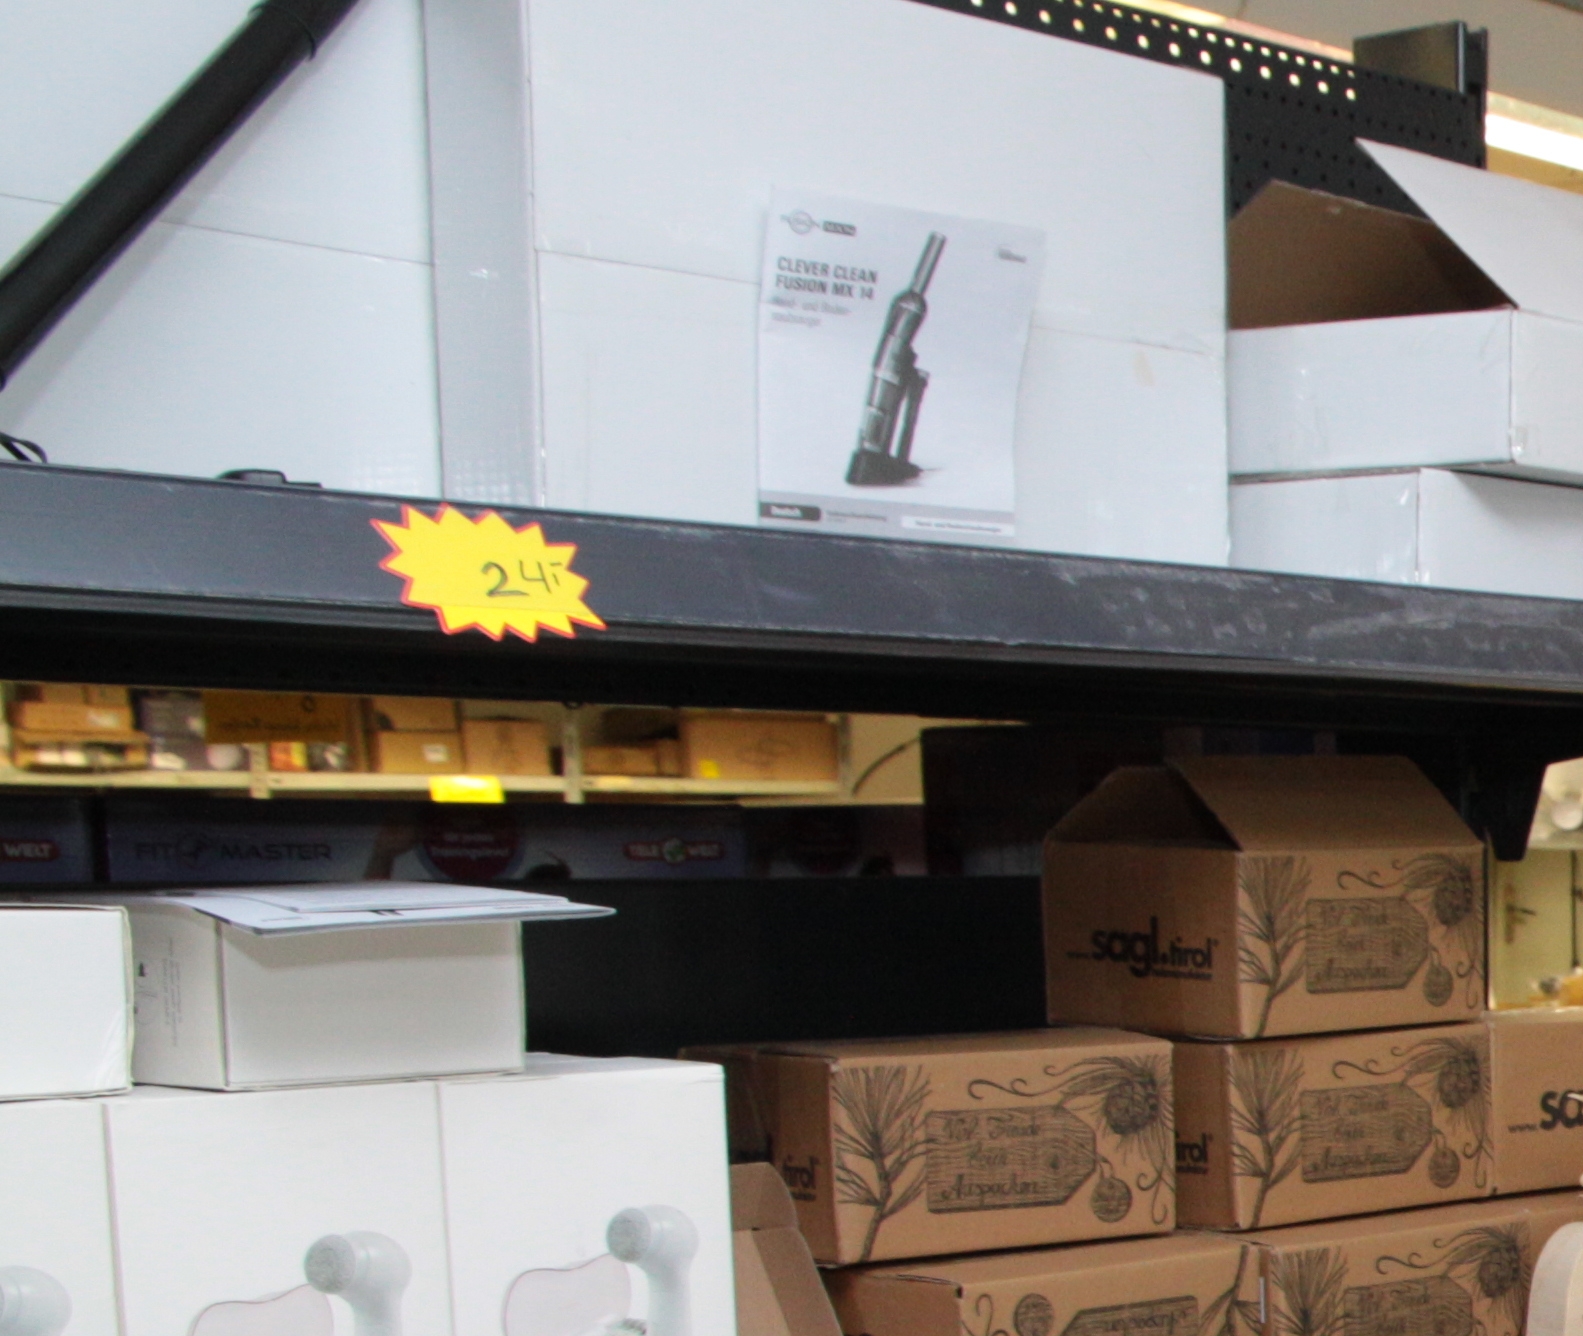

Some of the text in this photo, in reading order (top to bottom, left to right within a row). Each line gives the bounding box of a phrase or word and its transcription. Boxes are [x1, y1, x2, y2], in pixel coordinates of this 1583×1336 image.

[777, 256, 878, 284] CLEVER CLEAN
[775, 275, 827, 294] FUSION
